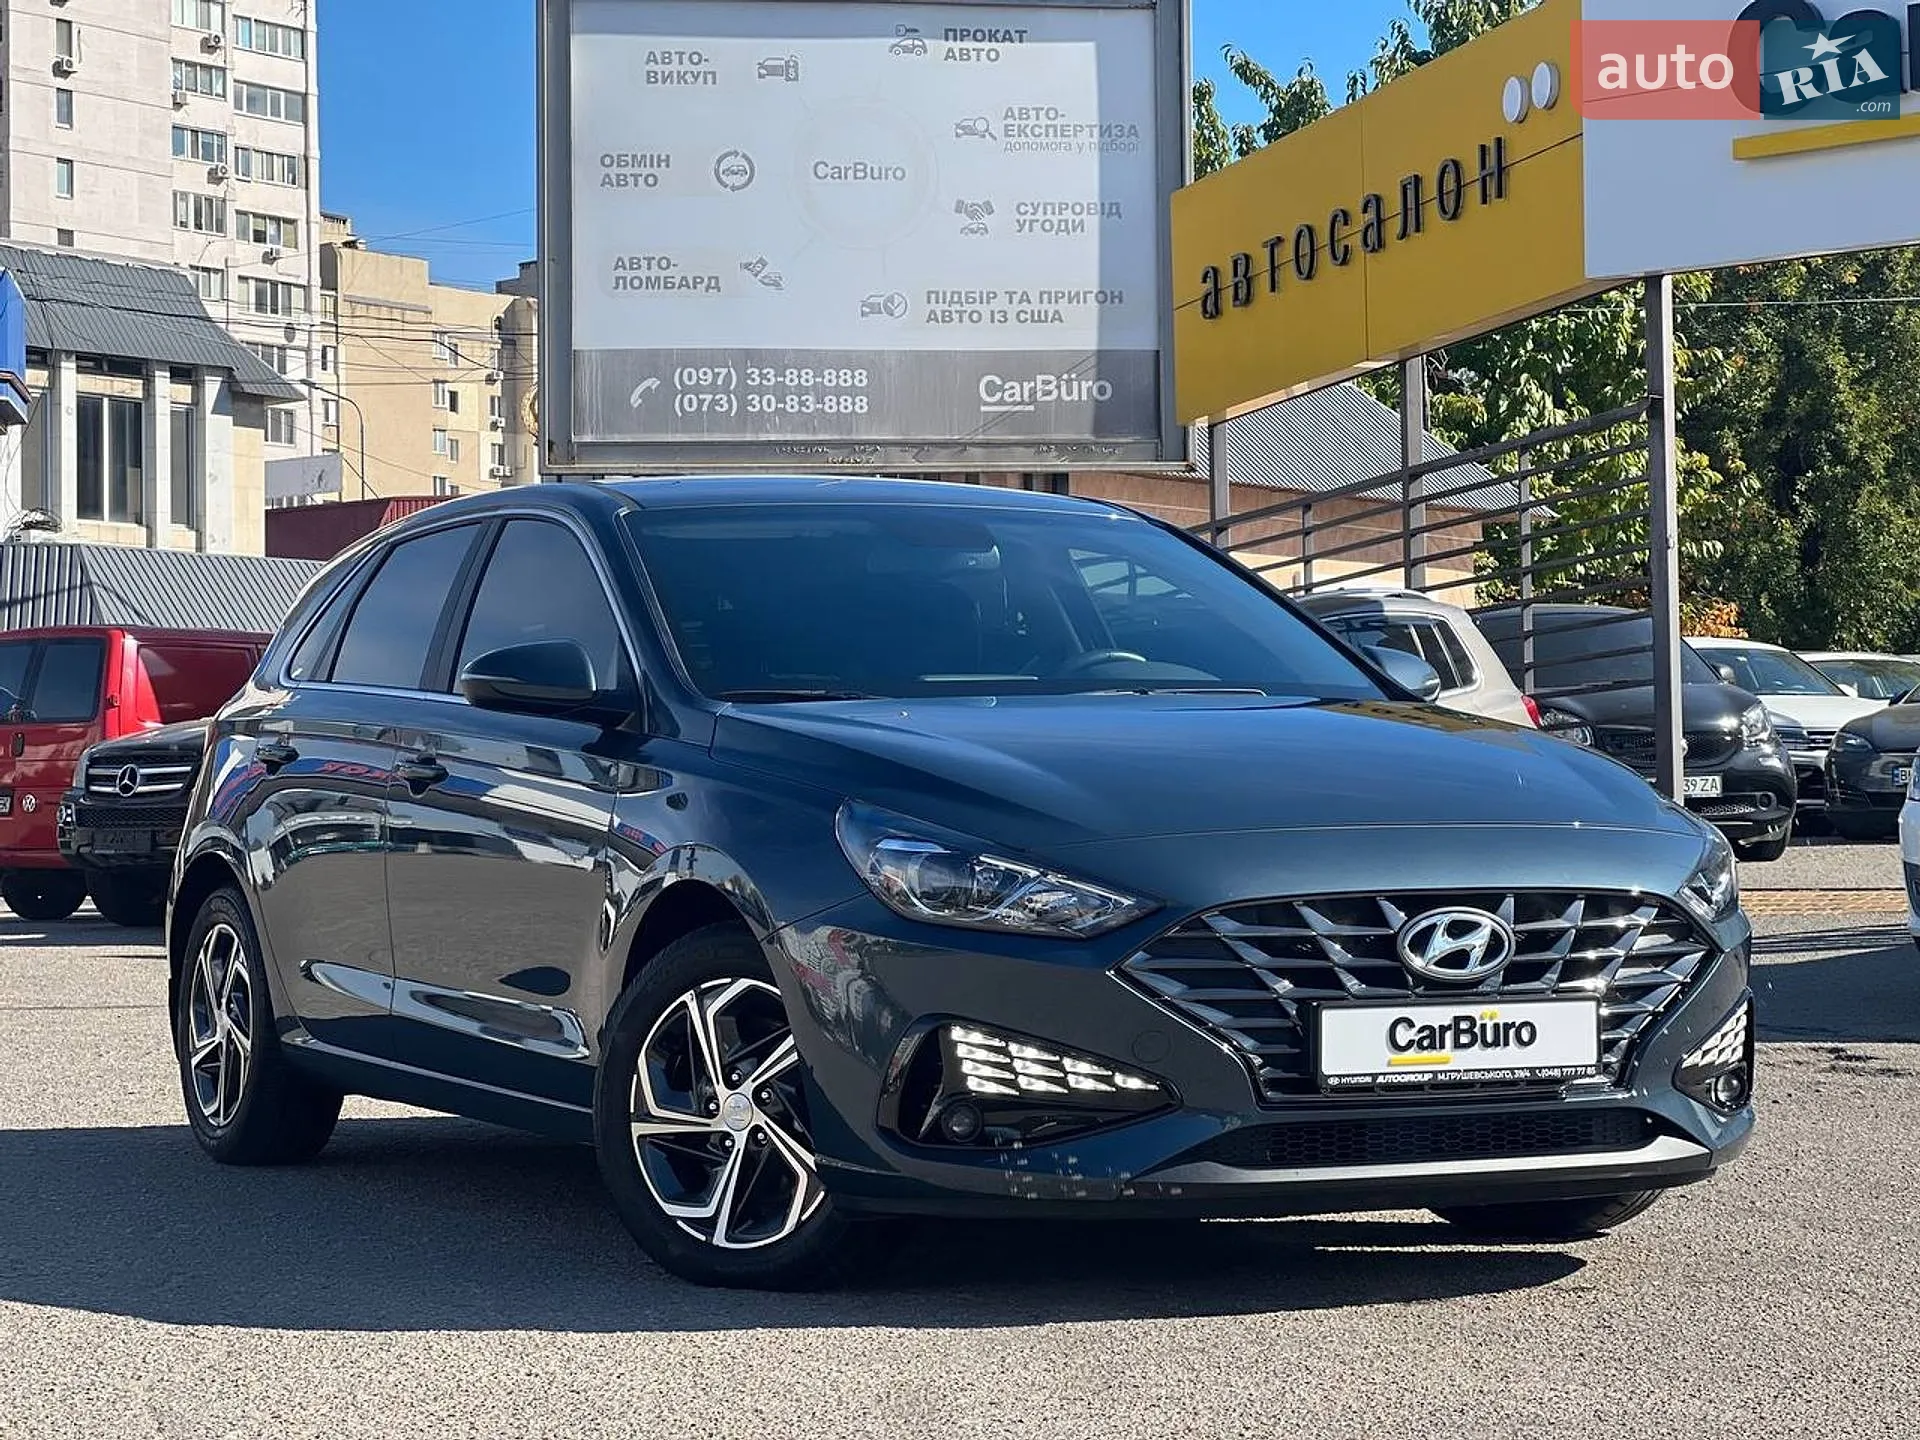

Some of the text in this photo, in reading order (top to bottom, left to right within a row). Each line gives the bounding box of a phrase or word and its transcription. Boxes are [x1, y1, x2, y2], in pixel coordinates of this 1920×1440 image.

[944, 28, 1028, 44] ПРОКАТ
[645, 50, 710, 66] АВТО-
[944, 48, 1001, 62] АВТО
[1727, 0, 1920, 117] Ca
[645, 70, 717, 86] ВИКУП
[1003, 107, 1066, 121] АВТО-
[1003, 124, 1140, 139] ЕКСПЕРТИЗА
[1003, 141, 1072, 153] допомога
[1077, 143, 1085, 153] у
[600, 154, 671, 169] ОБМІН
[813, 160, 906, 182] CarBuro
[600, 173, 659, 188] АВТО
[1015, 201, 1122, 219] СУПРОВІД
[1015, 218, 1085, 235] УГОДИ
[1200, 136, 1507, 320] автосалон
[613, 256, 678, 271] АВТО-
[612, 275, 722, 293] ЛОМБАРД
[926, 290, 1125, 307] ПІДБІР ТА ПРИГОН
[926, 309, 1064, 324] АВТО ІЗ США
[673, 366, 868, 390] (097) 33-88-888
[979, 373, 1113, 402] CarBüro
[673, 393, 869, 417] (073) 30-83-888
[1700, 778, 1718, 791] ZA
[1387, 1010, 1538, 1053] CarBüro
[1376, 1072, 1433, 1083] AUTOGROUP
